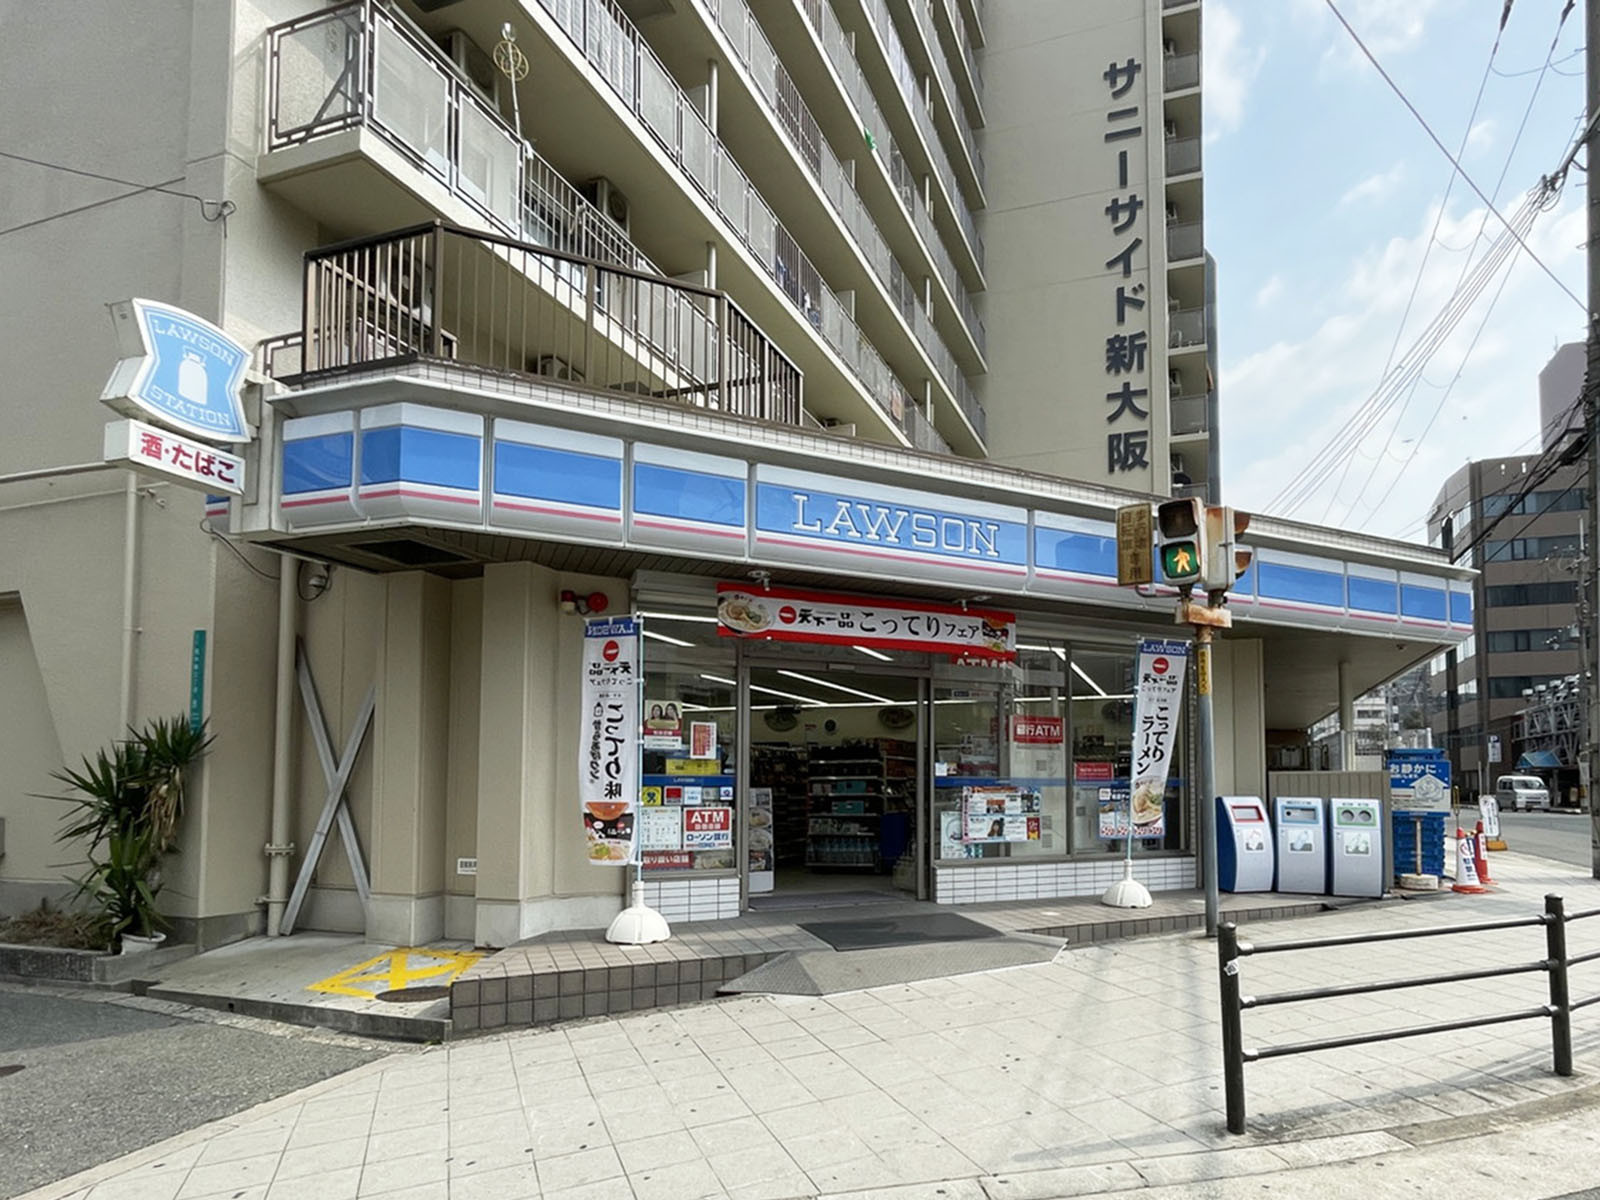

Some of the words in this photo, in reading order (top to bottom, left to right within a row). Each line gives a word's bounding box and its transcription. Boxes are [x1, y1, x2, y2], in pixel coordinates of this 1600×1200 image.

[1103, 57, 1149, 474] サニーサイド新大阪
[153, 319, 235, 367] LAWSON
[150, 384, 231, 426] STATION
[141, 431, 235, 484] 酒・たばこ
[792, 494, 999, 557] LAWSON
[798, 608, 854, 629] 天下一品
[859, 611, 980, 639] こってりフェア
[1143, 643, 1186, 654] LAWSON
[1137, 715, 1155, 776] ラーメン
[1152, 706, 1169, 763] こってり
[1390, 763, 1437, 774] お静かに
[690, 811, 724, 823] ATM
